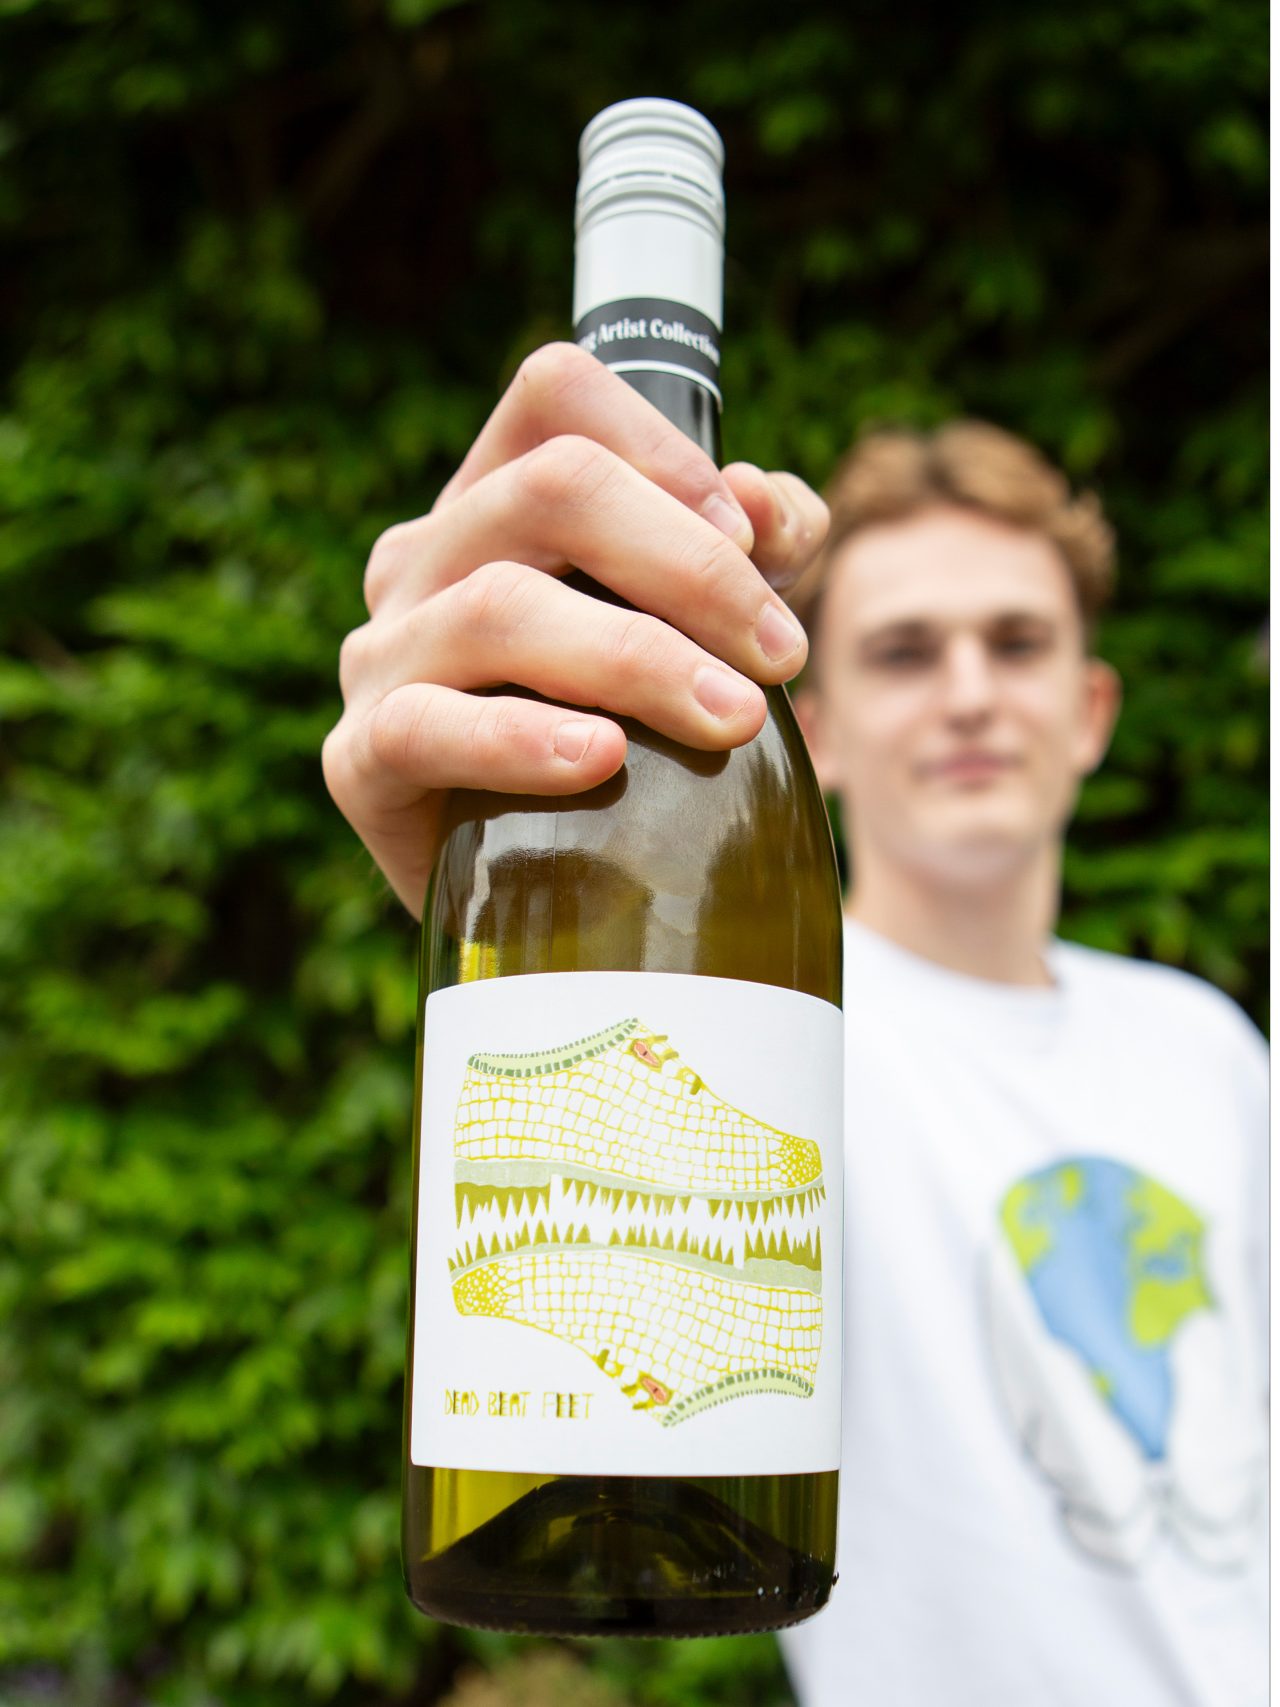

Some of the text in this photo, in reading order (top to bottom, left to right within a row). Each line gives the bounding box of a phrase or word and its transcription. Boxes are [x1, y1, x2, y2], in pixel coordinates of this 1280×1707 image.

[598, 317, 646, 345] Artist
[444, 1388, 594, 1419] DEAD BEAT FEET
